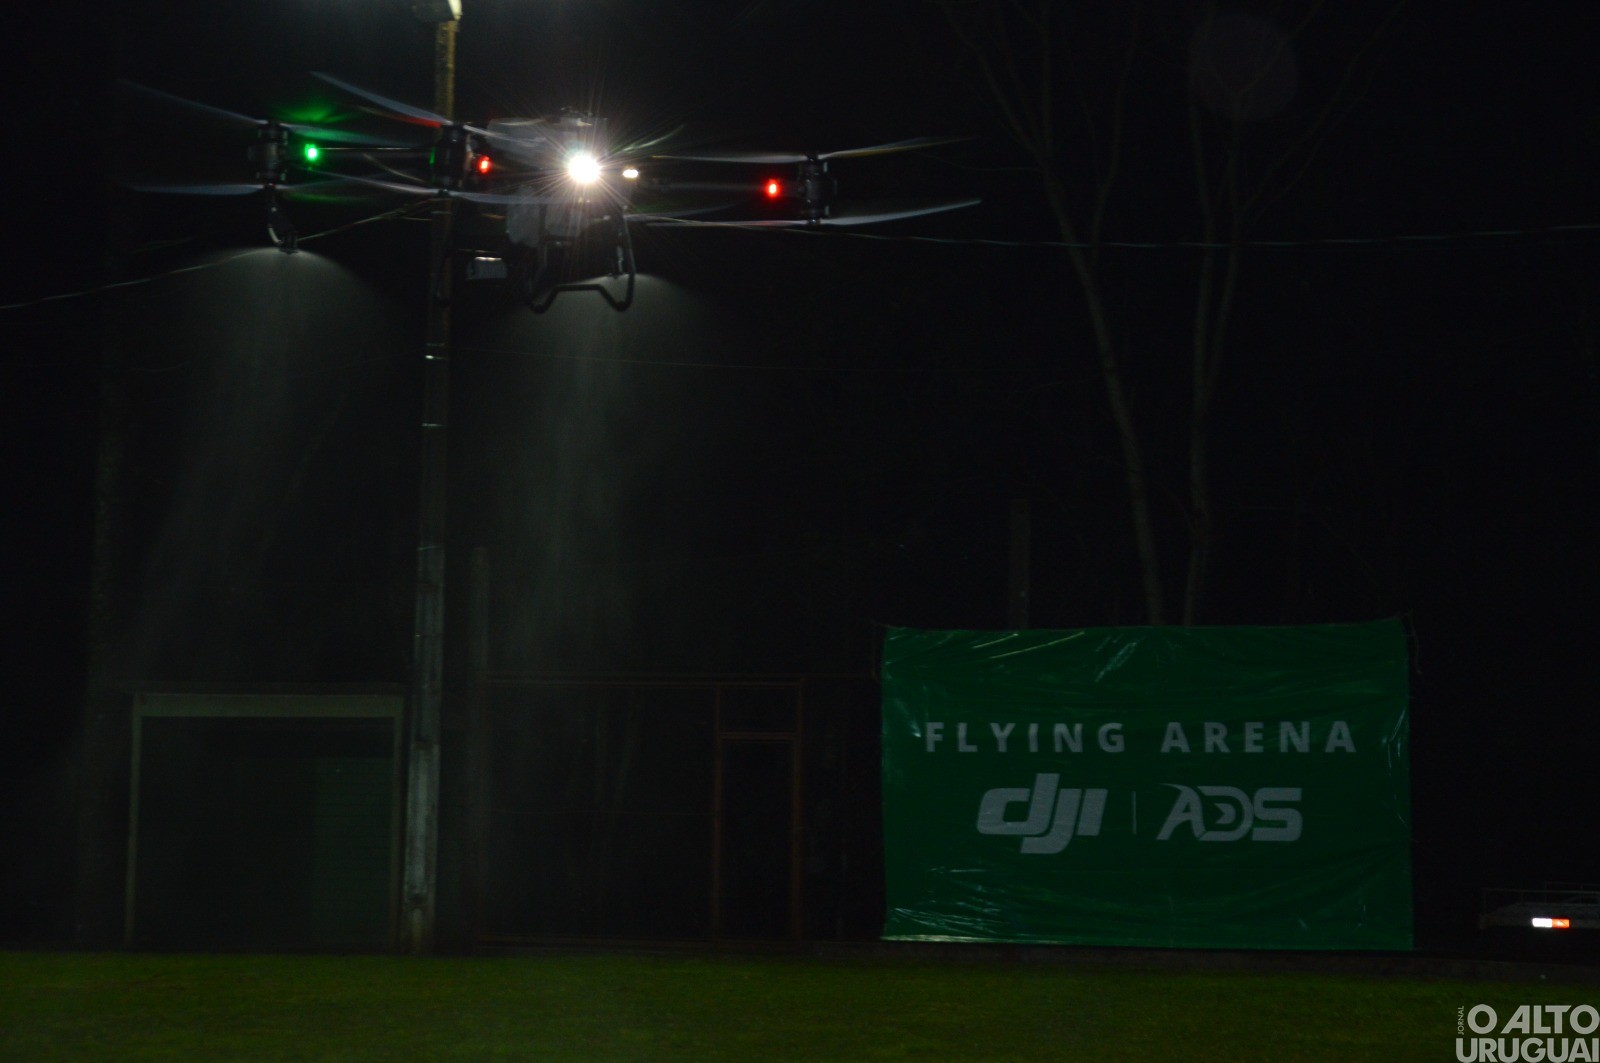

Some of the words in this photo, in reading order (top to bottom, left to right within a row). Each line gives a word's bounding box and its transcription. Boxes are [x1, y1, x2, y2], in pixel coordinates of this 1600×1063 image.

[924, 721, 1125, 753] FLYING
[1160, 720, 1357, 753] ARENA
[1155, 782, 1304, 842] ADS
